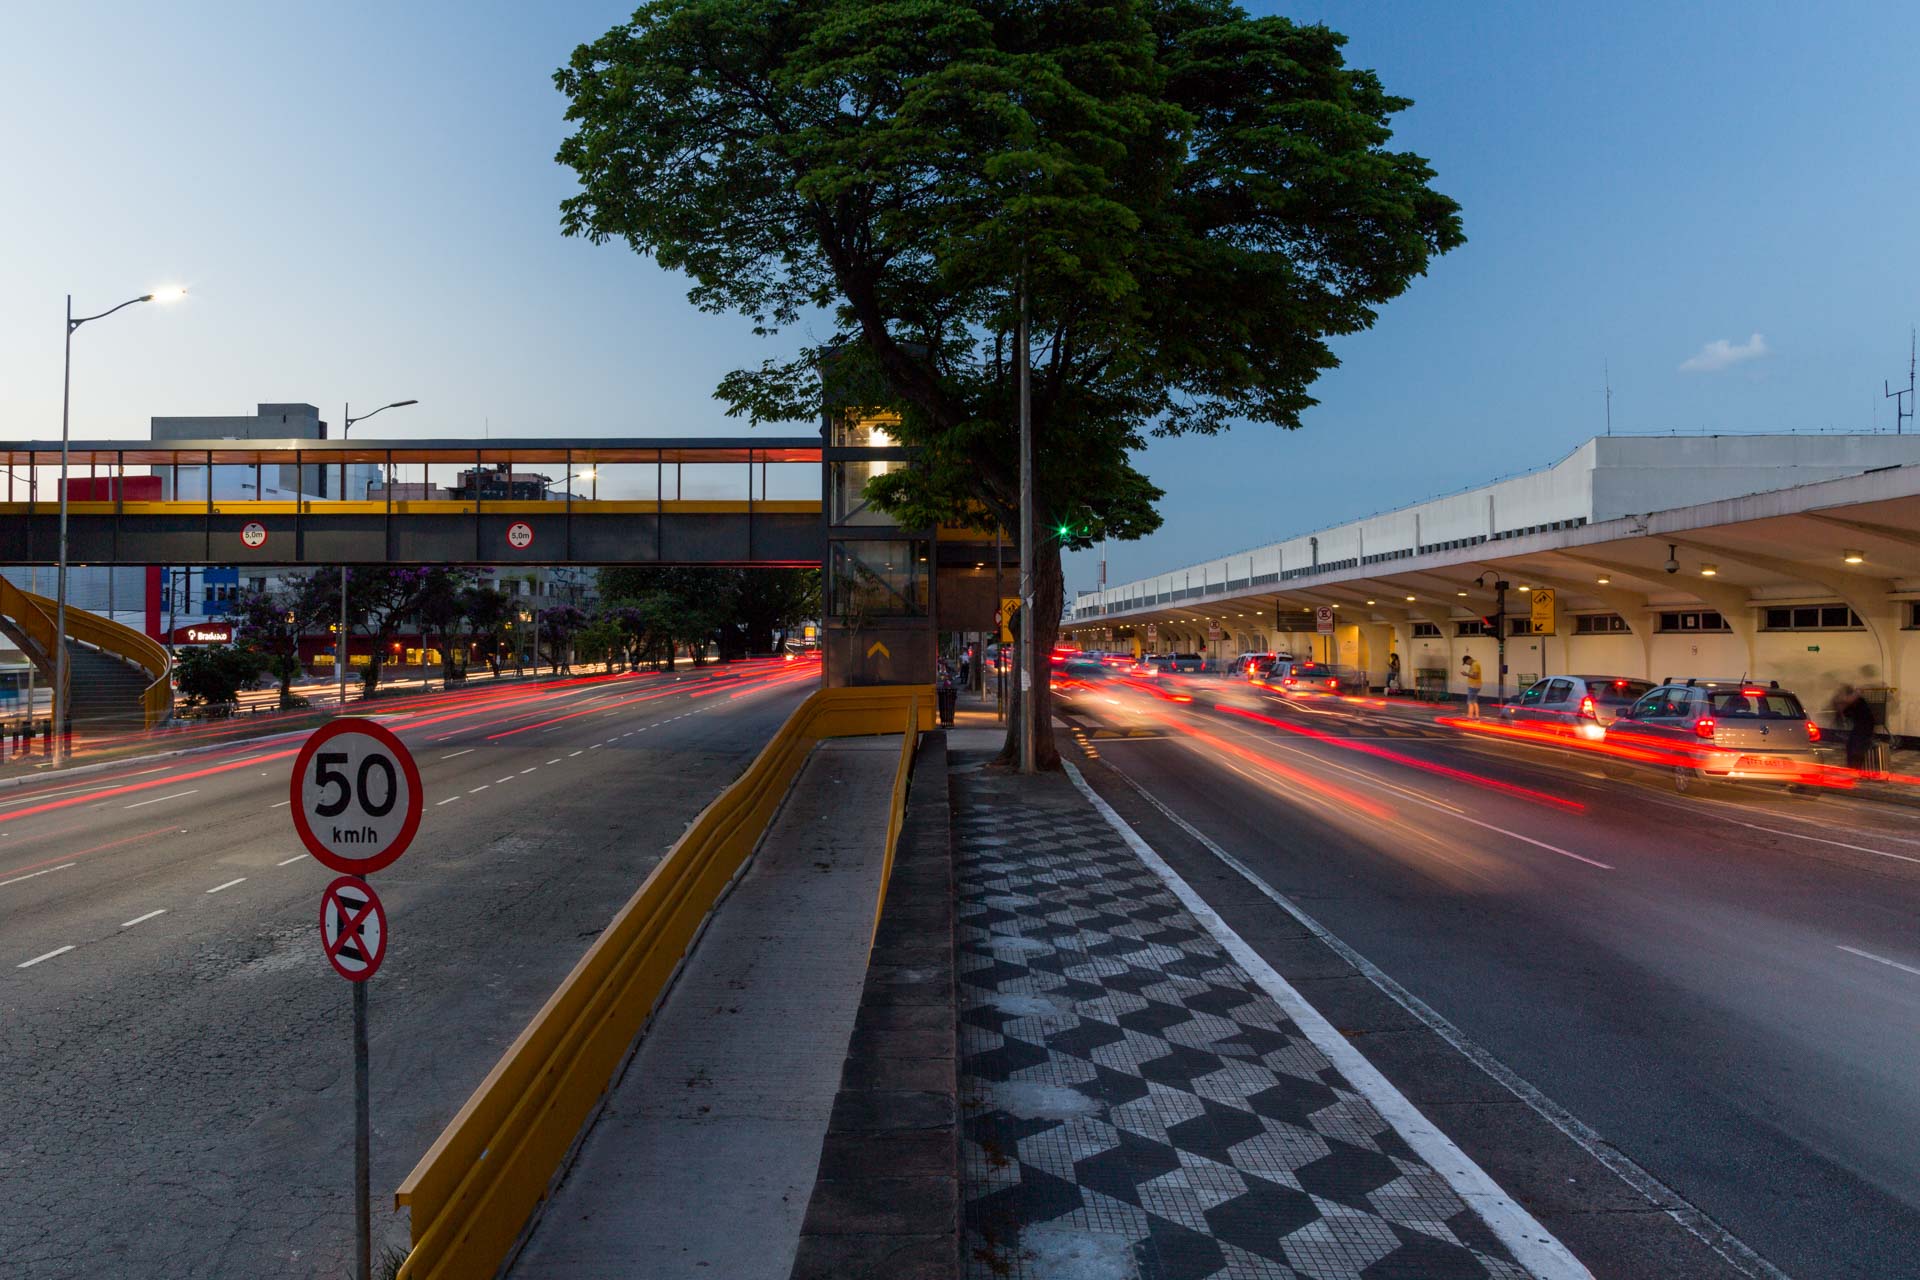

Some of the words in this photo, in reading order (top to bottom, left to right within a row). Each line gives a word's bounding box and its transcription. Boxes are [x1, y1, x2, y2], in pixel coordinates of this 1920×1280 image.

[245, 531, 263, 539] 5,0m
[511, 532, 530, 540] 5,0m
[314, 752, 398, 818] 50
[332, 826, 378, 844] km/h
